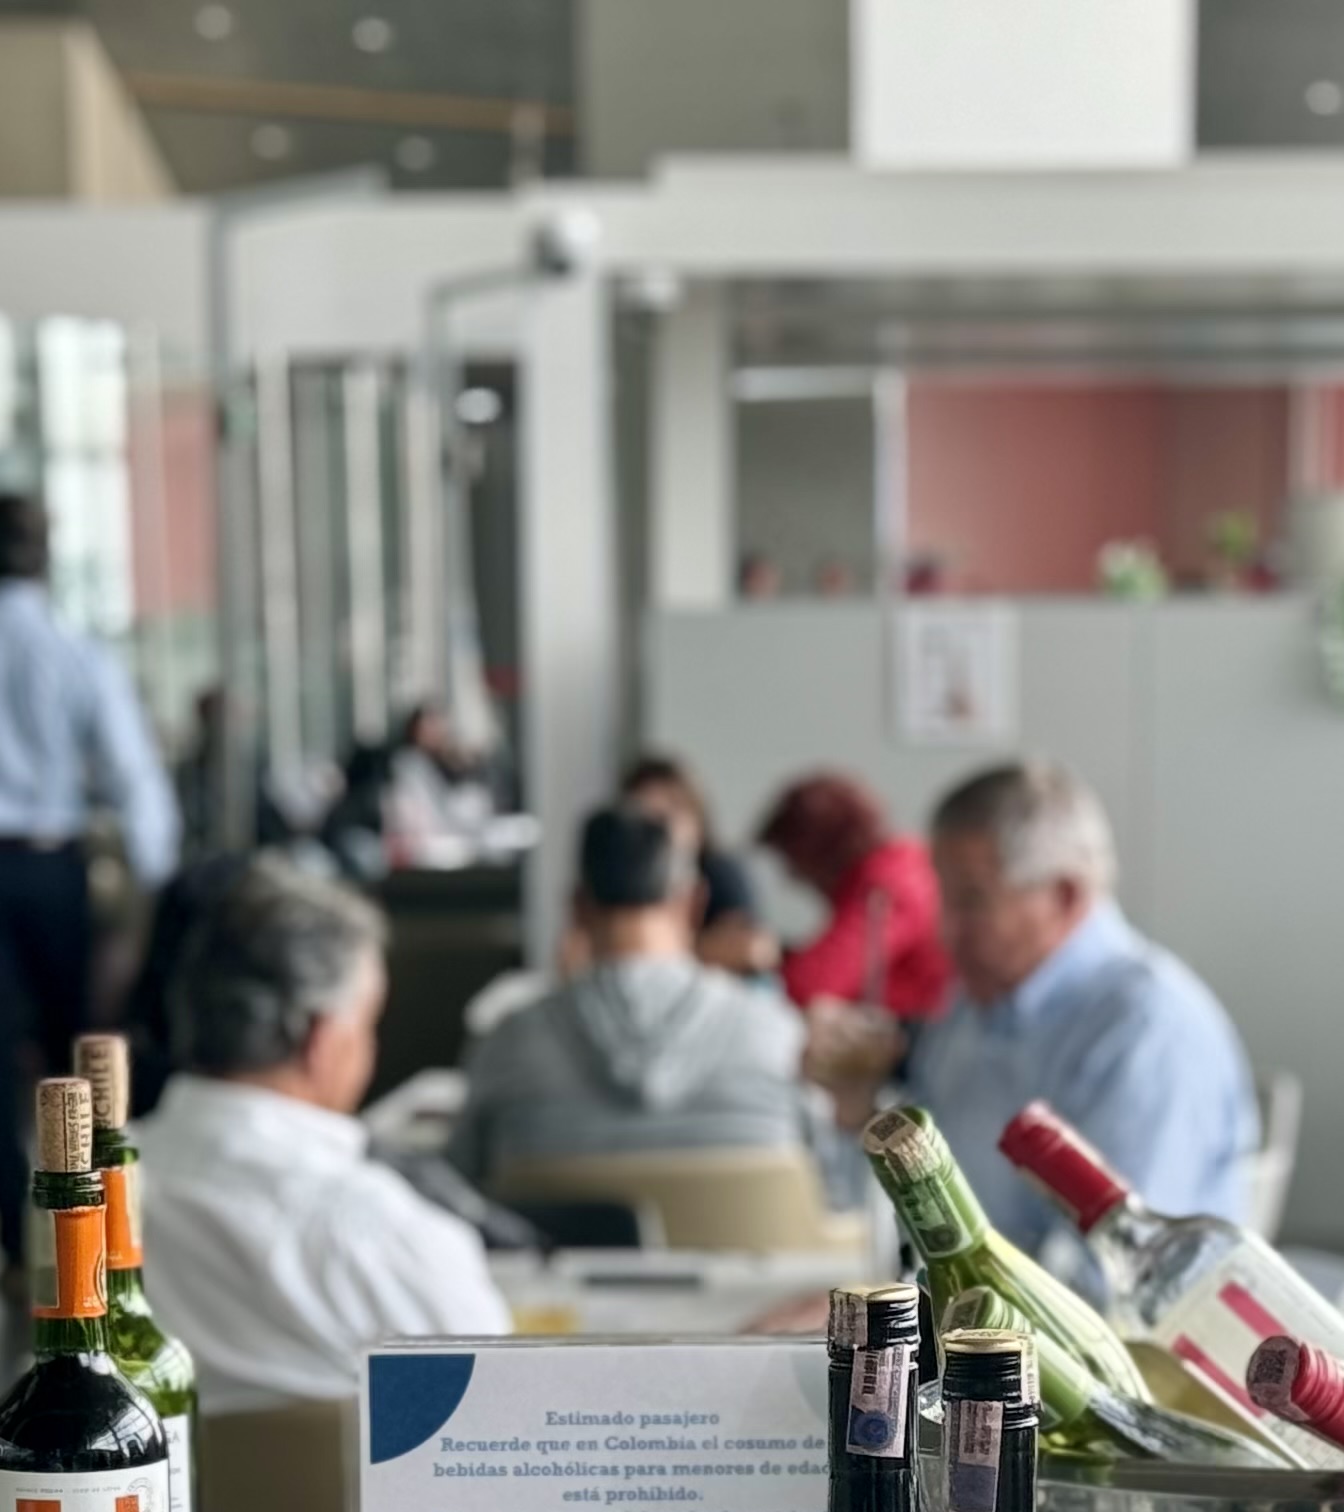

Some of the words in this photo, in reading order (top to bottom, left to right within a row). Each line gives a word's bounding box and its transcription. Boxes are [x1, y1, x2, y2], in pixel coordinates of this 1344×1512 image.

[544, 1411, 636, 1427] Estimado
[639, 1411, 721, 1430] pasajero
[440, 1436, 532, 1453] Recuerde
[535, 1439, 571, 1456] que
[575, 1439, 599, 1451] en
[603, 1435, 697, 1451] Colombia
[701, 1435, 719, 1451] el
[723, 1438, 798, 1451] cosumo
[801, 1434, 825, 1450] de
[432, 1461, 509, 1478] bebidas
[512, 1461, 621, 1477] alcohólicas
[623, 1464, 668, 1480] para
[671, 1464, 755, 1476] menores
[758, 1460, 783, 1476] de
[561, 1486, 602, 1502] está
[604, 1485, 705, 1506] prohibido.
